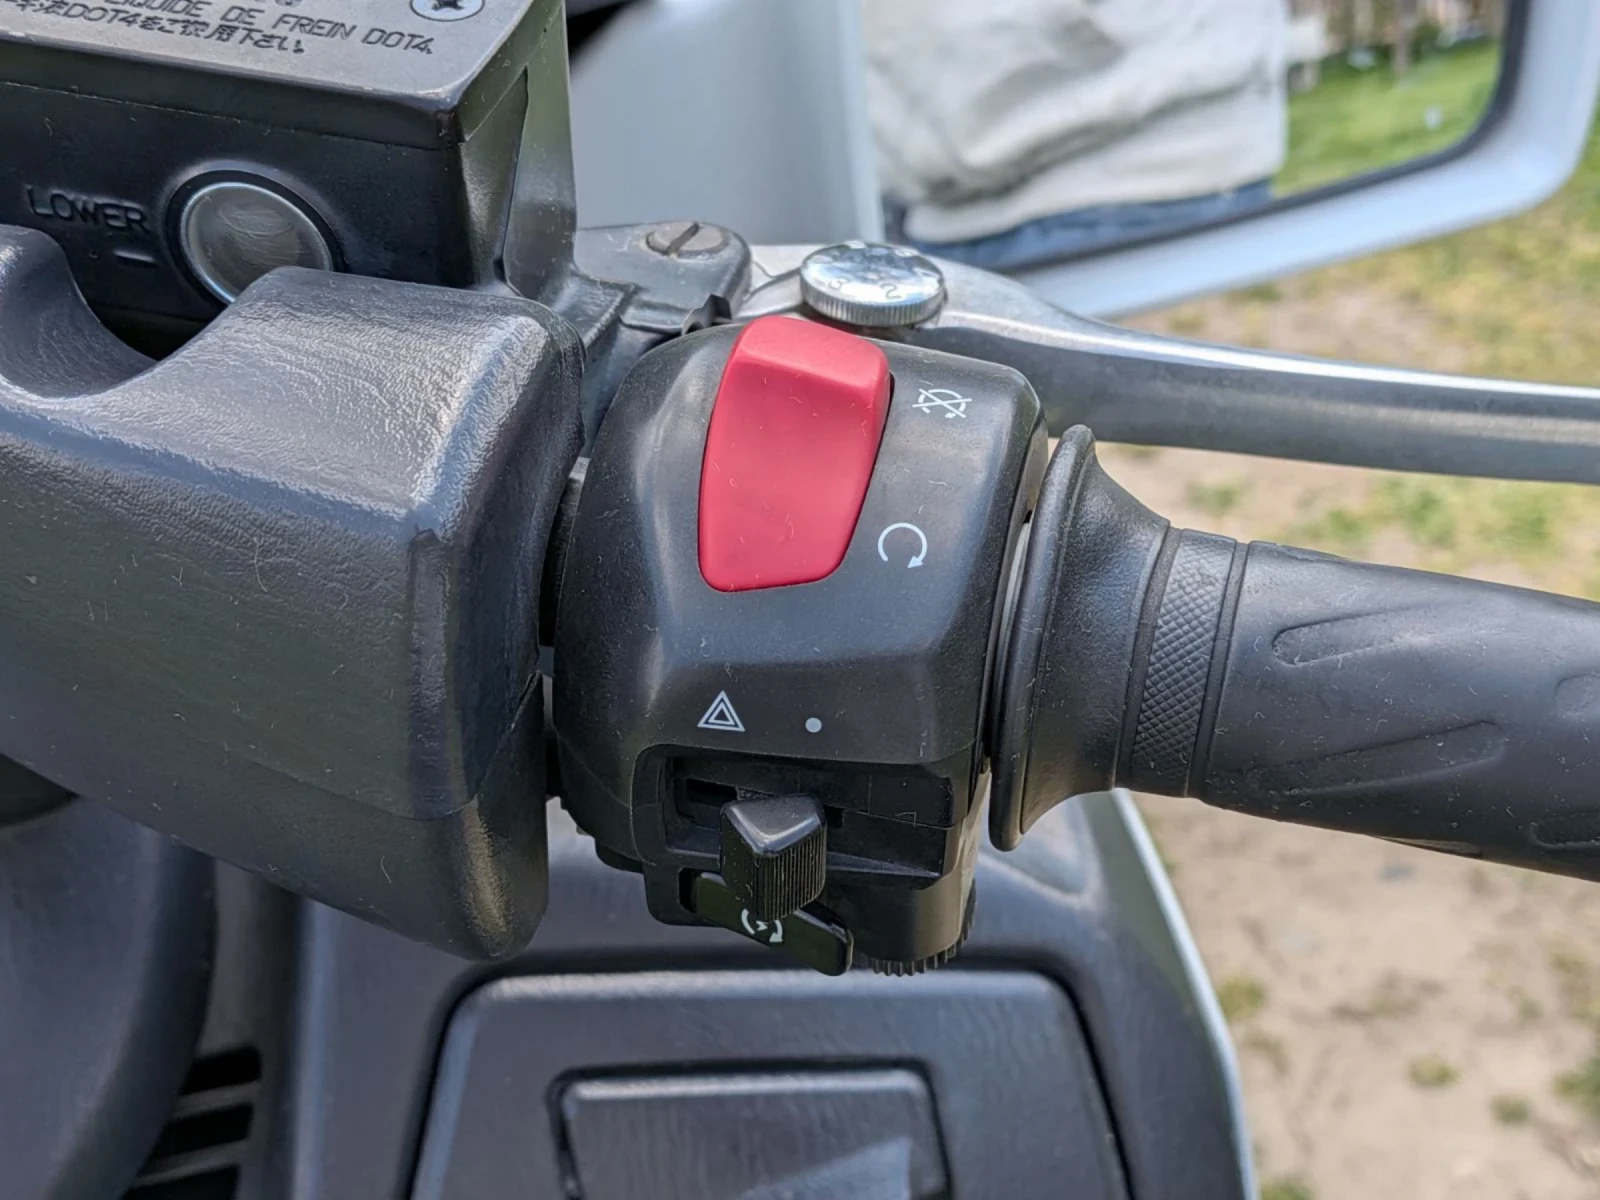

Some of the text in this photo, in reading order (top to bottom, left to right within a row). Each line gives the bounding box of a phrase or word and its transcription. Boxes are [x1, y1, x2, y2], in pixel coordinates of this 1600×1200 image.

[102, 0, 212, 17] UIDE
[220, 6, 265, 25] DE
[272, 13, 357, 40] FREIN
[26, 184, 151, 233] LOWER
